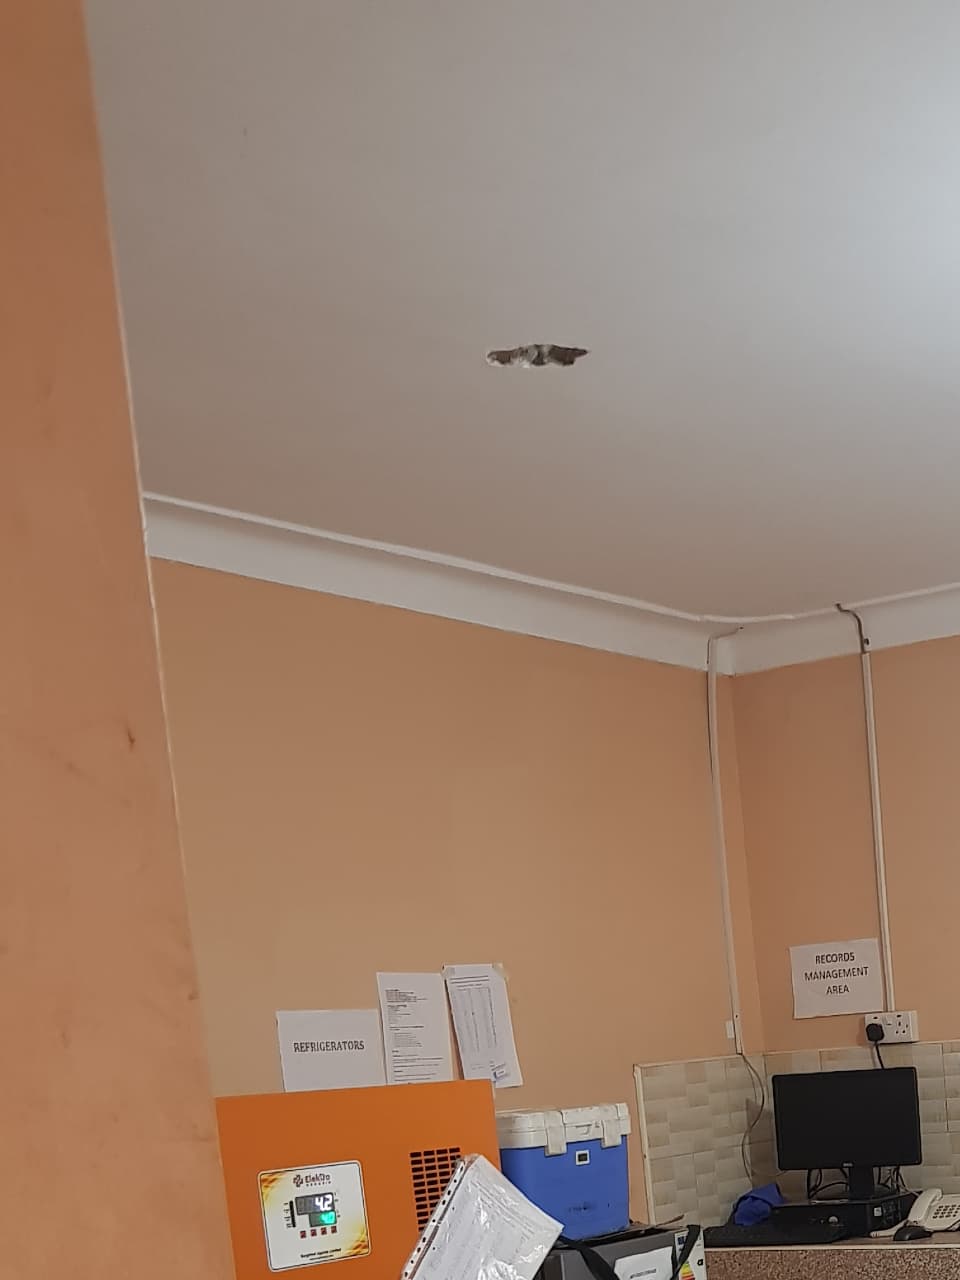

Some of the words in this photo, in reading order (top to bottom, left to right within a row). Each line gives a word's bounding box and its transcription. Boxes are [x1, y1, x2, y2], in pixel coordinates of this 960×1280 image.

[815, 951, 855, 965] RECORDS
[804, 966, 869, 981] MANAGEMENT
[826, 984, 850, 995] AREA
[293, 1040, 365, 1053] REFRIGERATORS
